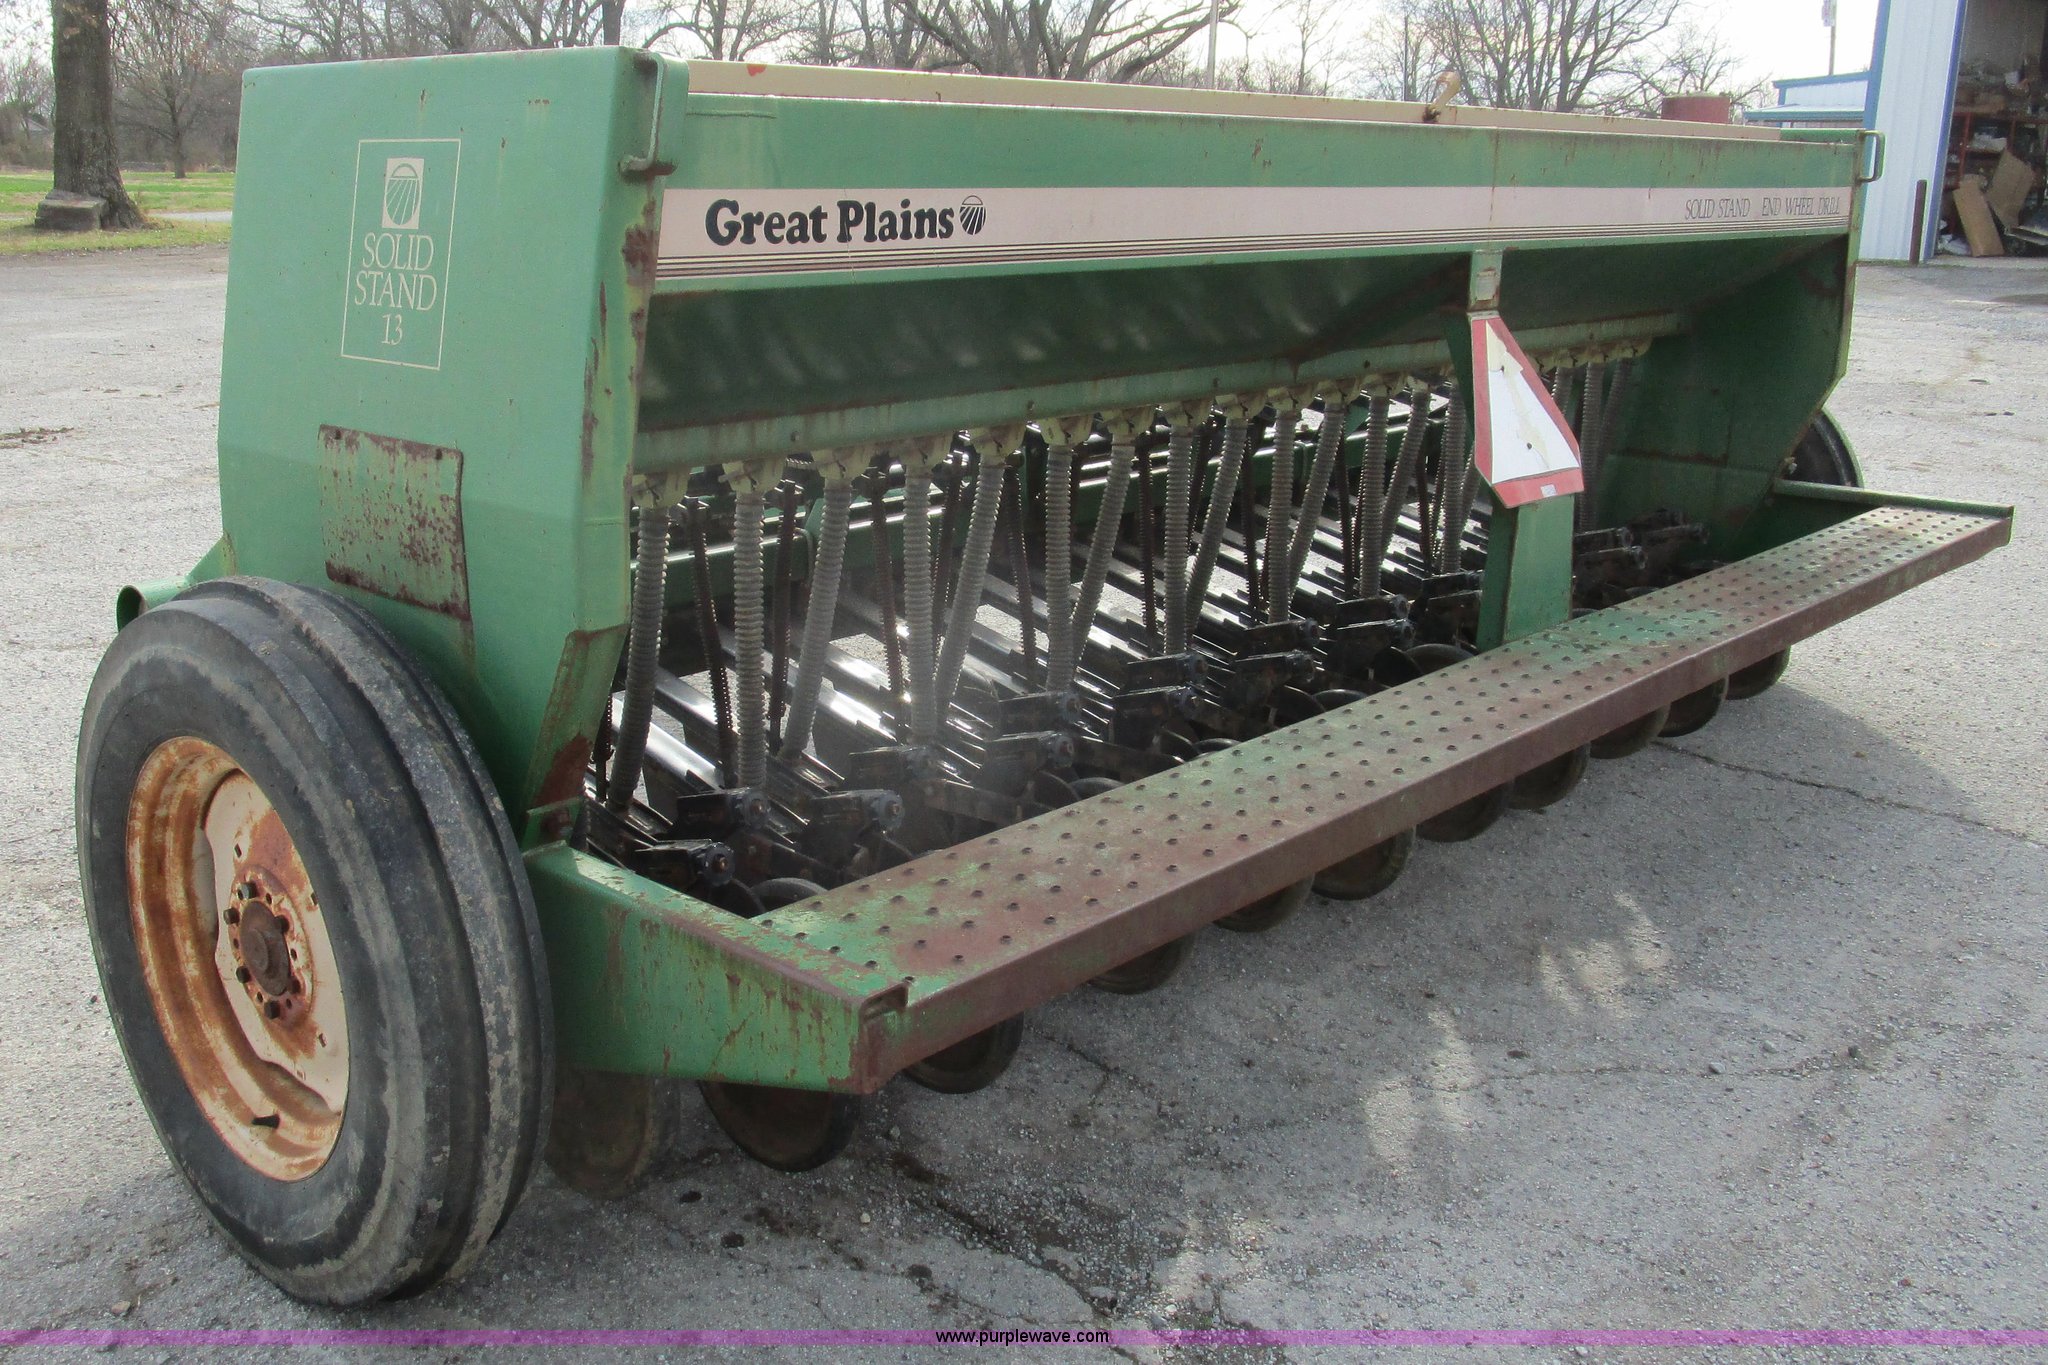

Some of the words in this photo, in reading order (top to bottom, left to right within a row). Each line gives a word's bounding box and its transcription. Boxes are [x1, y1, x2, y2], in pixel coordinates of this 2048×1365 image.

[705, 198, 828, 246] Great
[836, 198, 955, 243] Plains
[1684, 198, 1716, 220] SOLID
[1717, 198, 1751, 219] STAND
[1761, 197, 1782, 217] END
[1785, 197, 1814, 216] WHEEL
[1817, 196, 1841, 216] DRILL
[362, 232, 434, 271] SOLID
[354, 270, 437, 311] STAND
[381, 313, 404, 346] 13
